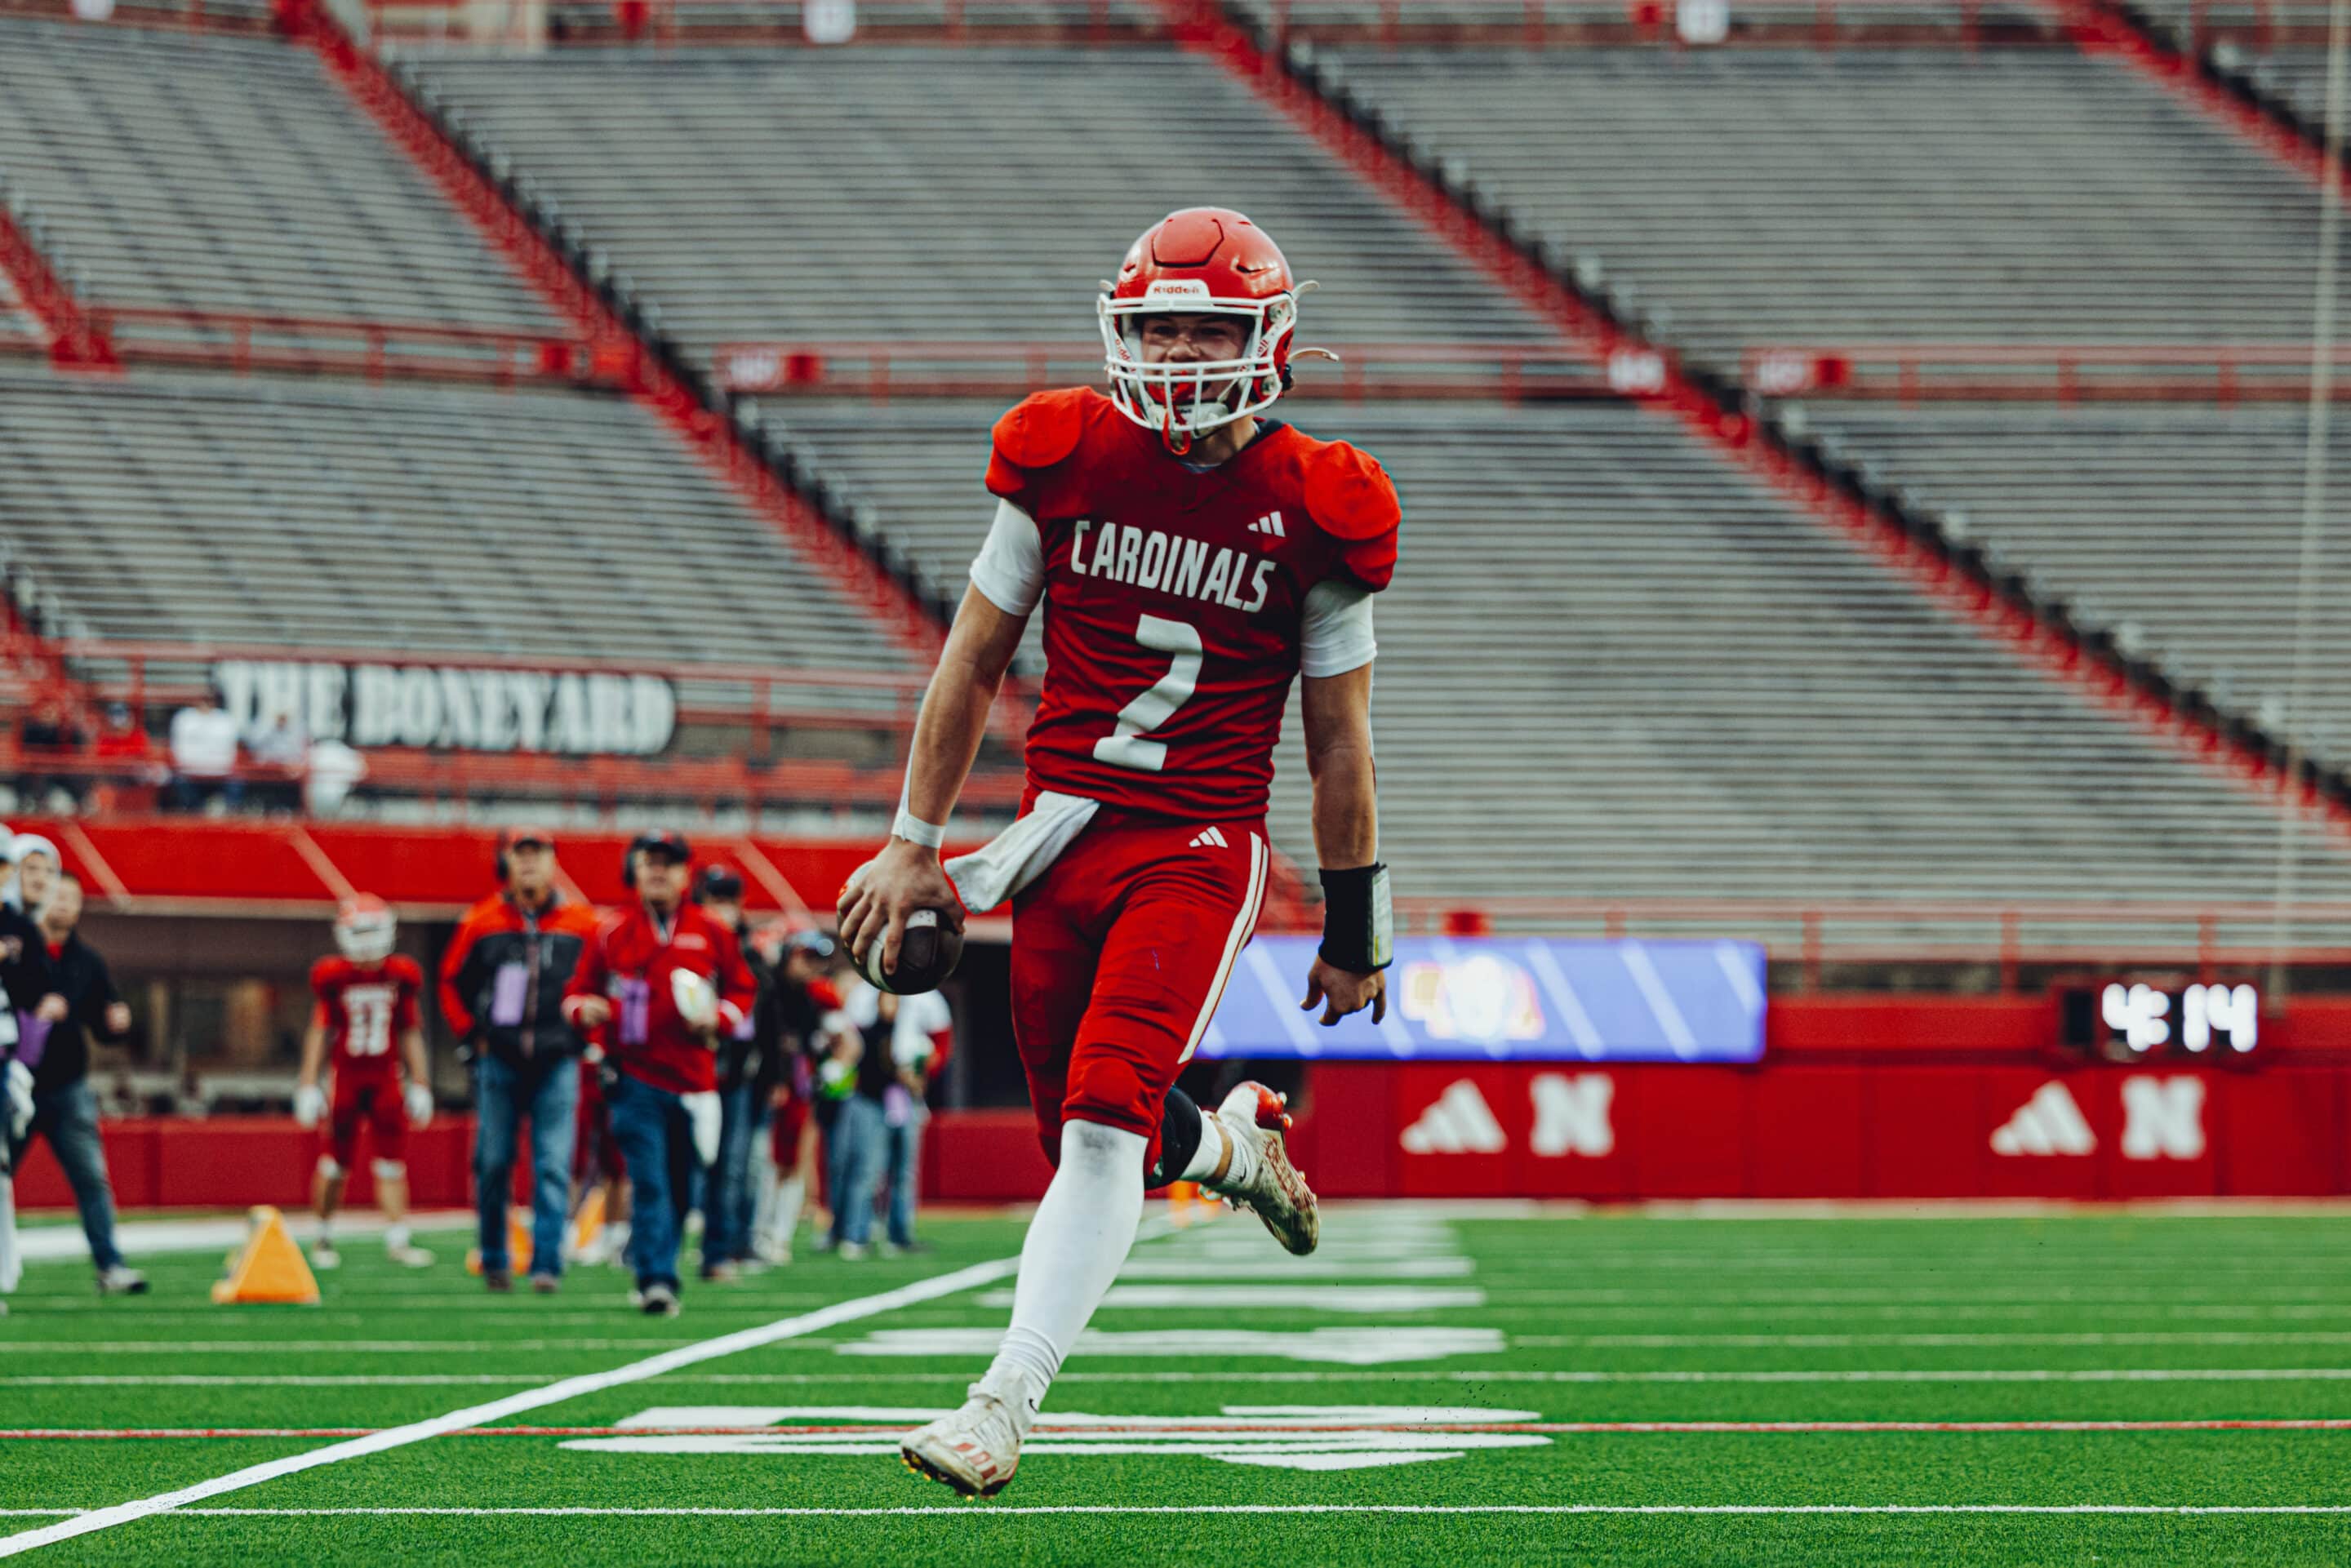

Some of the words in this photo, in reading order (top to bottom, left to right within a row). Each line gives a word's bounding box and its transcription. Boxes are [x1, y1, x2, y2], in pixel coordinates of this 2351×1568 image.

[1071, 520, 1277, 613] CARDINALS
[353, 664, 675, 754] BONEYARD
[1092, 613, 1203, 771] 2
[2102, 983, 2258, 1052] 4:14
[1530, 1073, 1614, 1157] N
[2121, 1075, 2206, 1160] N
